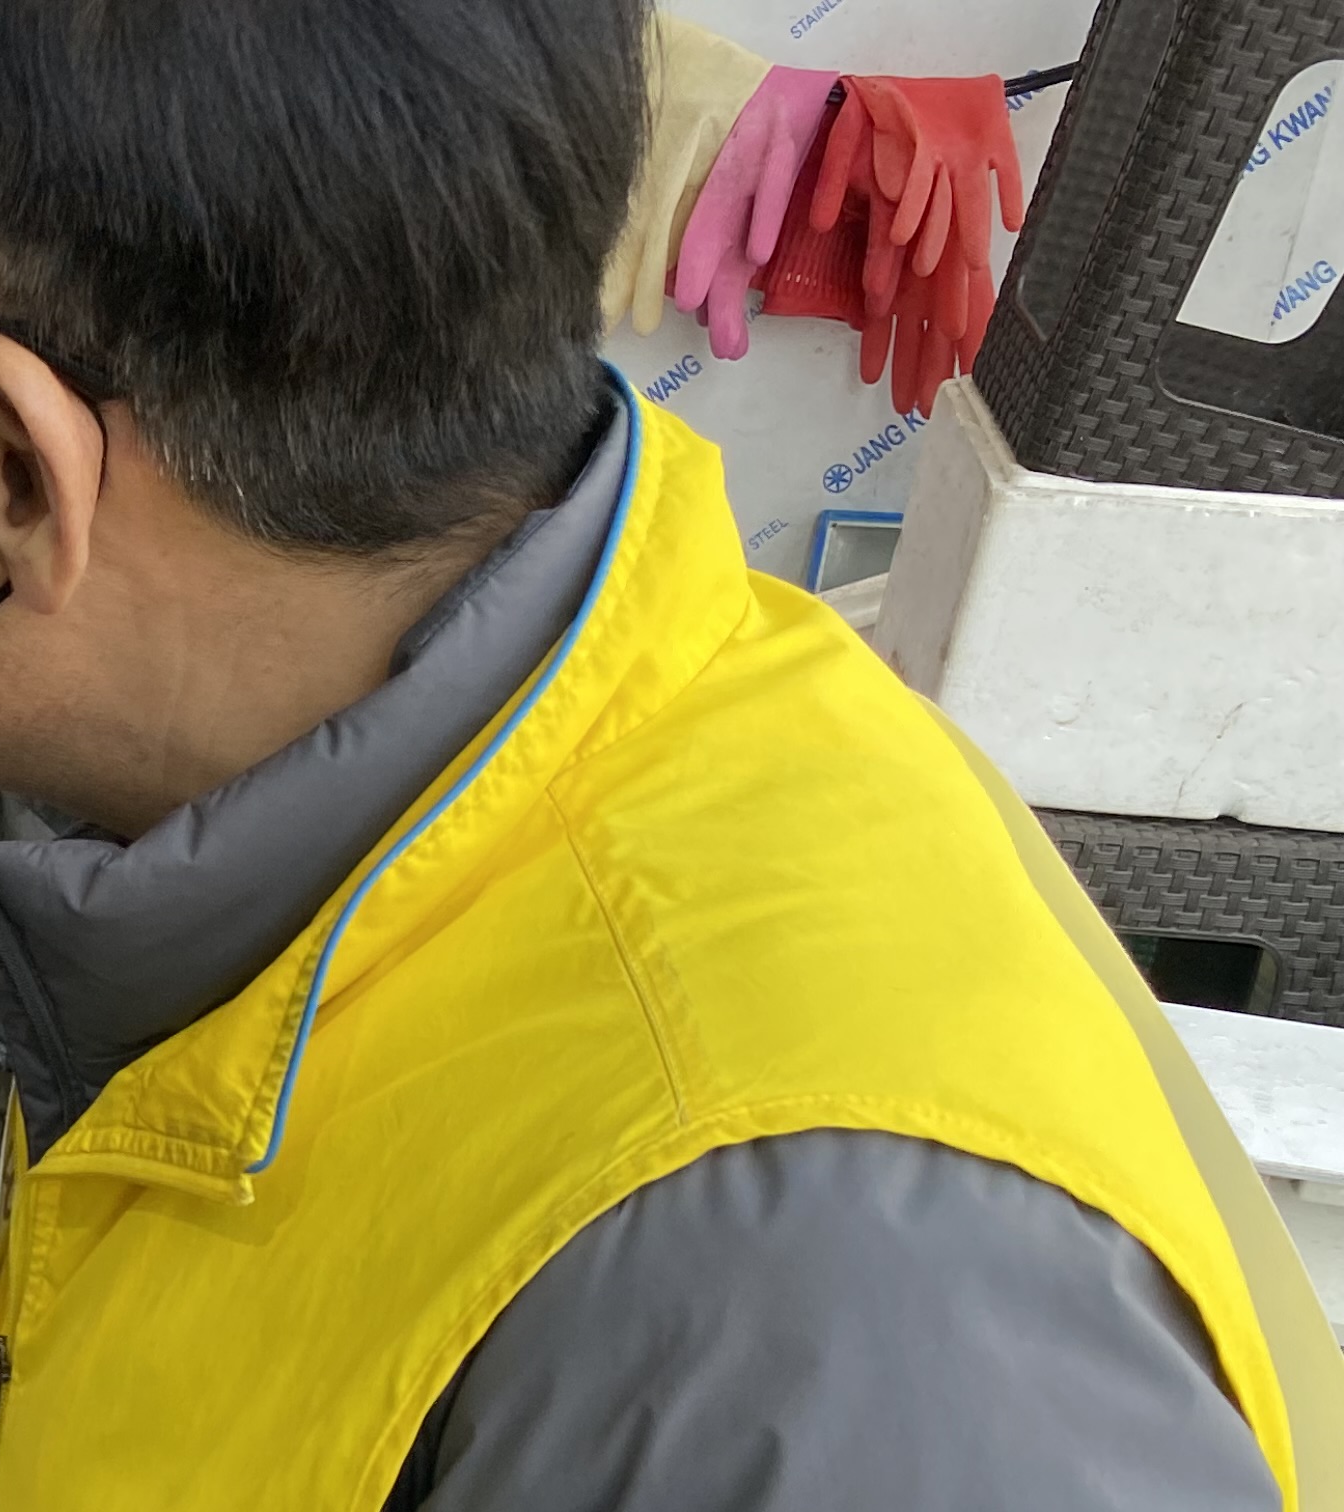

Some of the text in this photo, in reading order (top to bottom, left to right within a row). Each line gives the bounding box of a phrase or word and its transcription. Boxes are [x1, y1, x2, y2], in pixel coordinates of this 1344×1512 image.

[790, 0, 842, 39] STAINL
[1267, 82, 1334, 150] KWAN
[1273, 260, 1337, 320] WANG
[642, 354, 703, 403] WANG
[853, 424, 906, 475] JANG
[748, 517, 789, 551] STEEL
